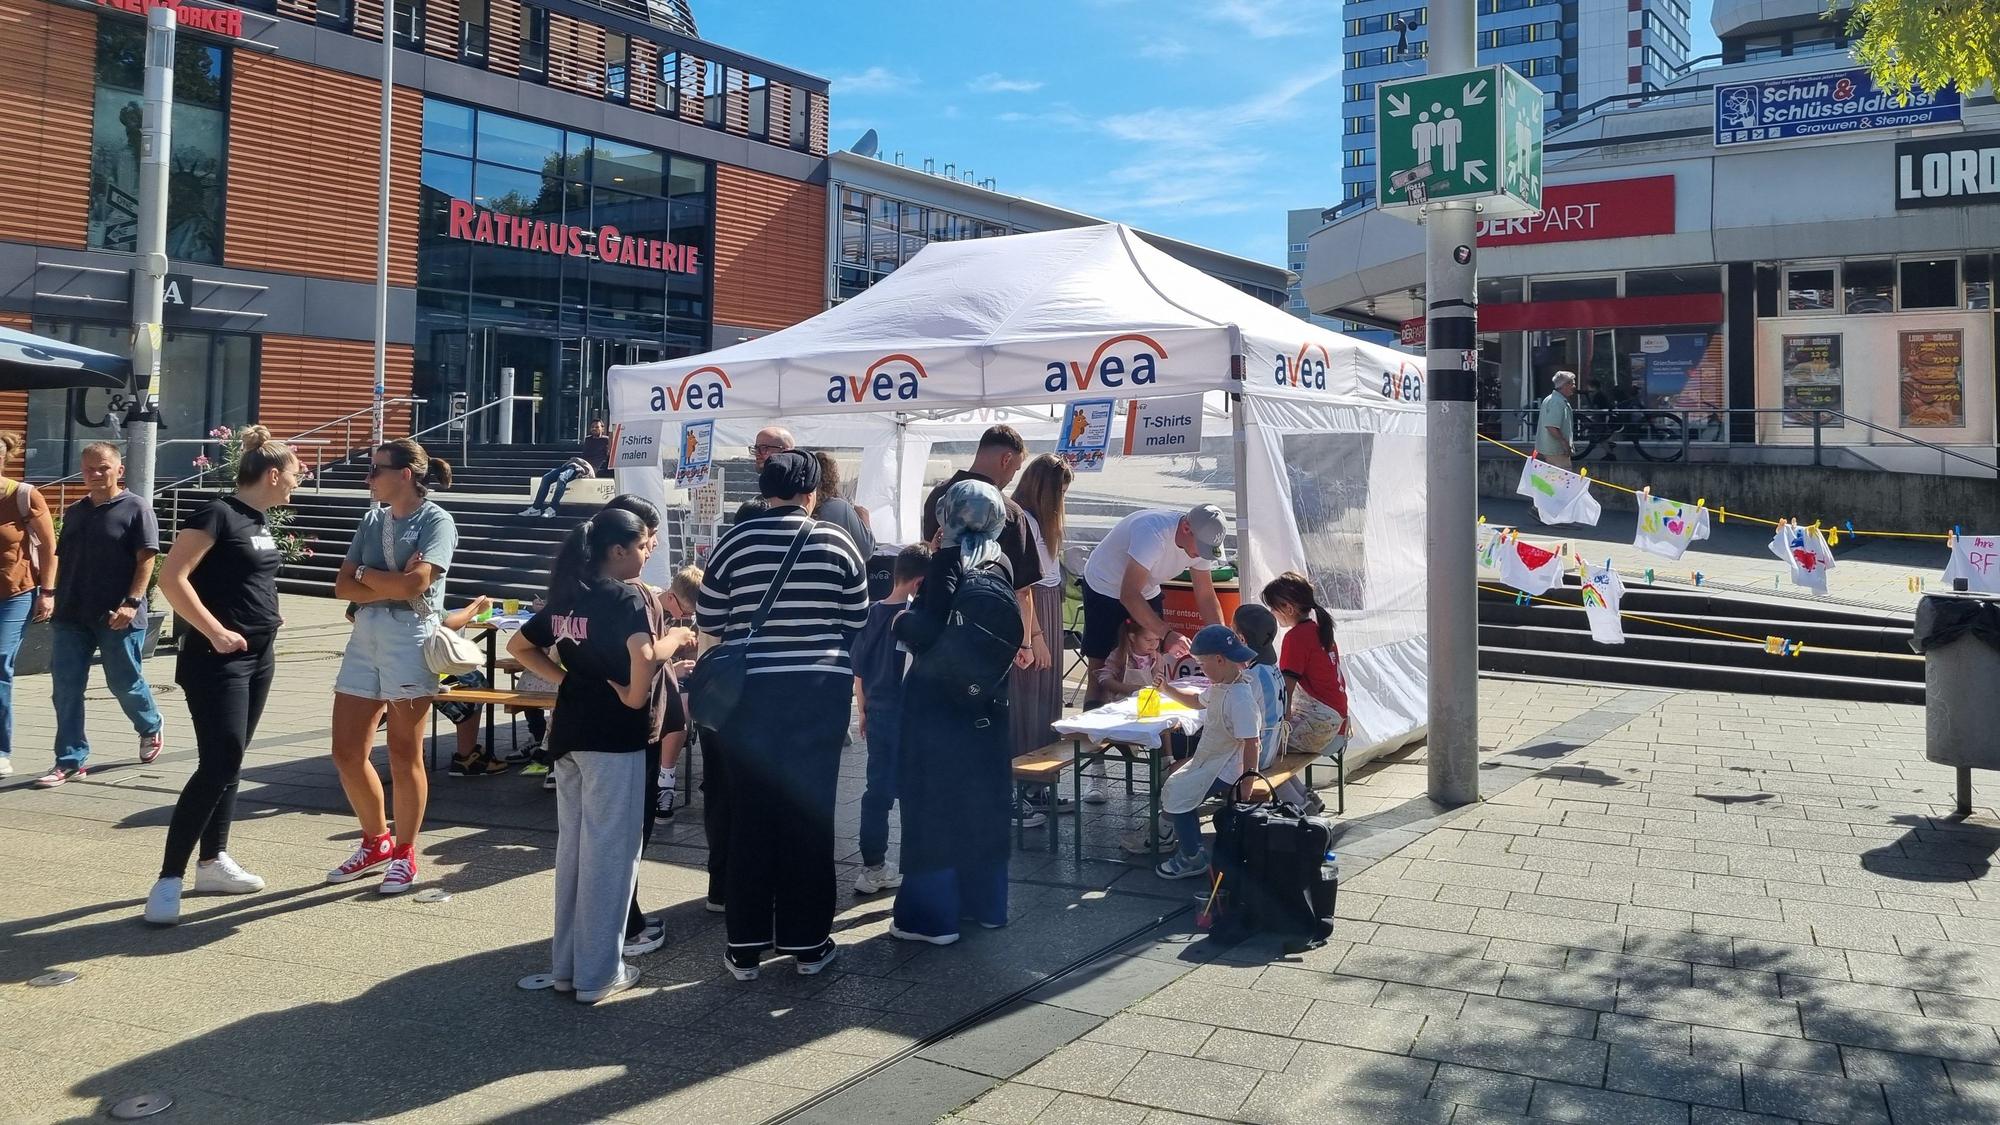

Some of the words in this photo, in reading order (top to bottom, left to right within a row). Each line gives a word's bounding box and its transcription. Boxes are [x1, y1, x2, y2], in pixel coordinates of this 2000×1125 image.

[1762, 82, 1828, 104] Schuh
[1832, 78, 1856, 101] &
[1796, 119, 1857, 134] Gravuren
[1860, 117, 1873, 129] &
[1875, 111, 1932, 127] Stempel
[1900, 147, 2000, 200] LORD
[450, 198, 699, 274] RATHAUS-GALERIE
[826, 356, 927, 403] avea
[1045, 336, 1168, 392] avea
[1275, 343, 1330, 390] avea
[1382, 362, 1424, 401] avea
[650, 367, 732, 412] avea
[621, 435, 652, 446] T-Shirts
[1142, 414, 1192, 429] T-Shirts
[1146, 434, 1185, 447] malen
[621, 450, 647, 460] malen
